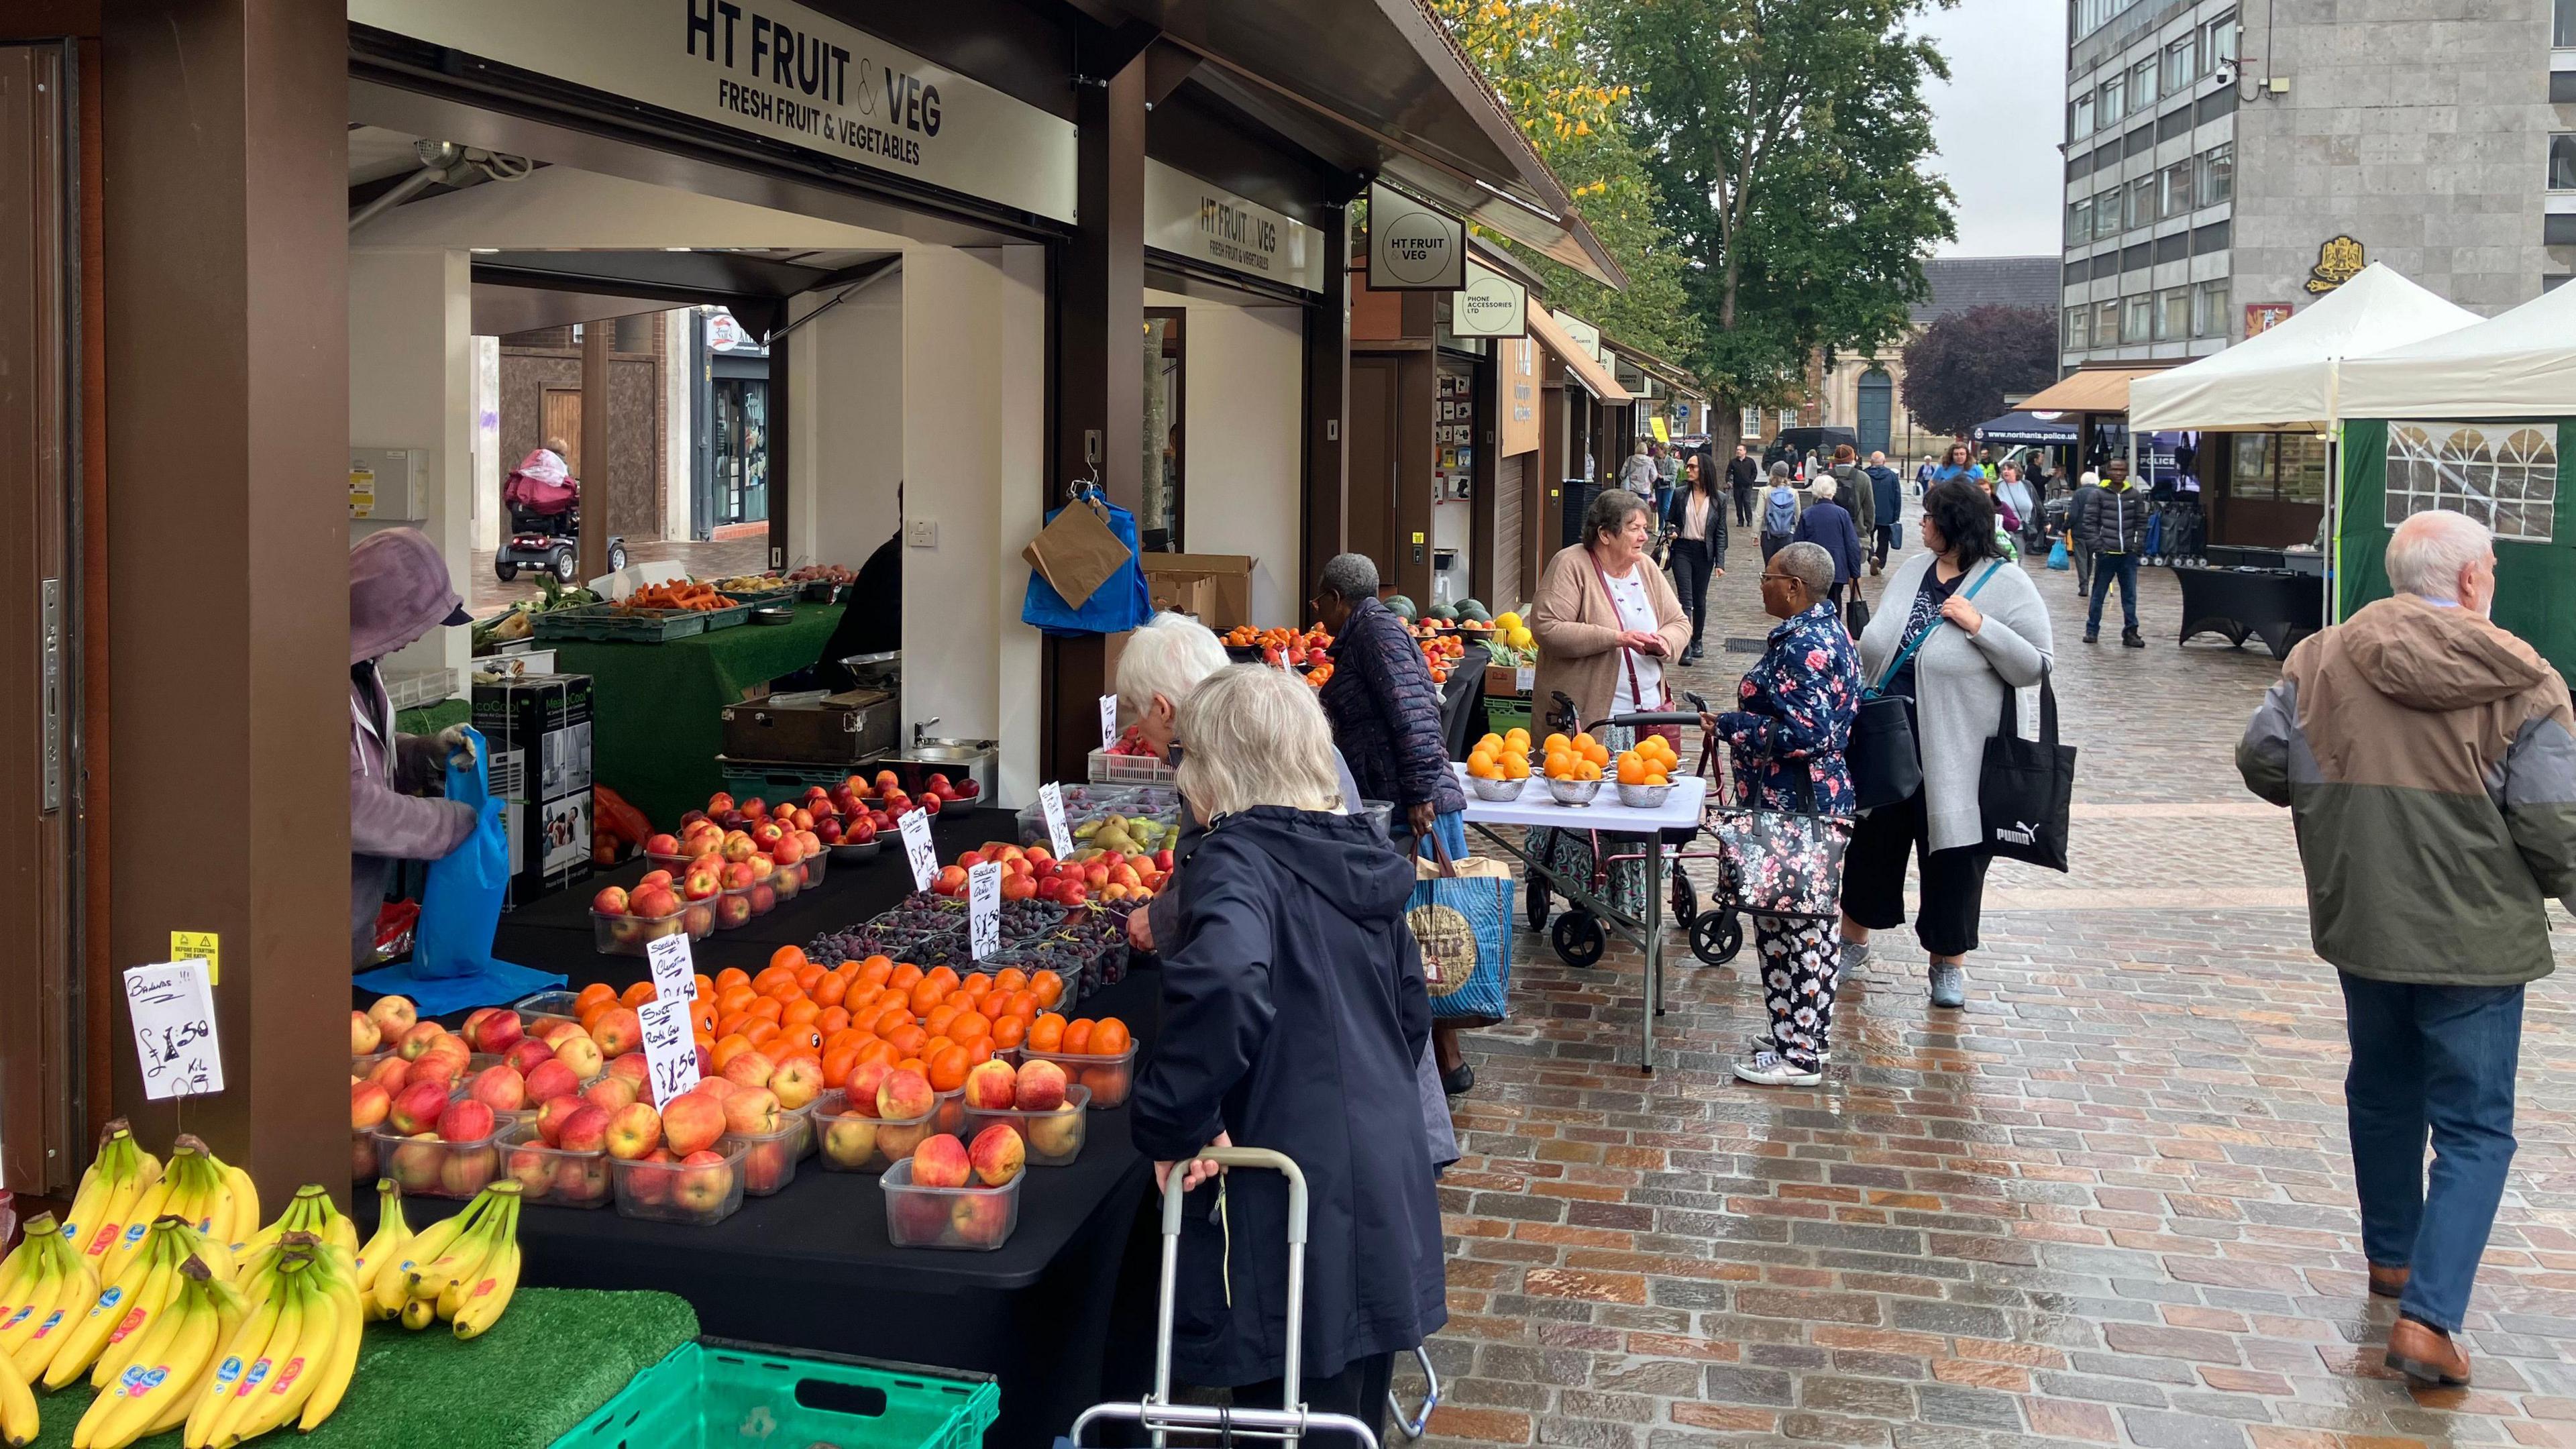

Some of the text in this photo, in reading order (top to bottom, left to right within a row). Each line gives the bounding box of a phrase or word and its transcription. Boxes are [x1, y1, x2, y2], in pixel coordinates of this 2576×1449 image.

[687, 0, 941, 137] HT FRUIT & VEG
[719, 78, 920, 166] FRESH FRUIT & VEGETABLES
[1201, 196, 1216, 233] HT
[1218, 203, 1246, 244] FRUIT
[1257, 218, 1275, 254] VEG
[1210, 239, 1269, 270] FRESH FRUIT & VEGETABLES
[1391, 239, 1444, 248] HT FRUIT
[1391, 250, 1427, 260] & VEG
[1988, 431, 2078, 440] www.northants.police.uk
[1996, 828, 2029, 845] PUMA
